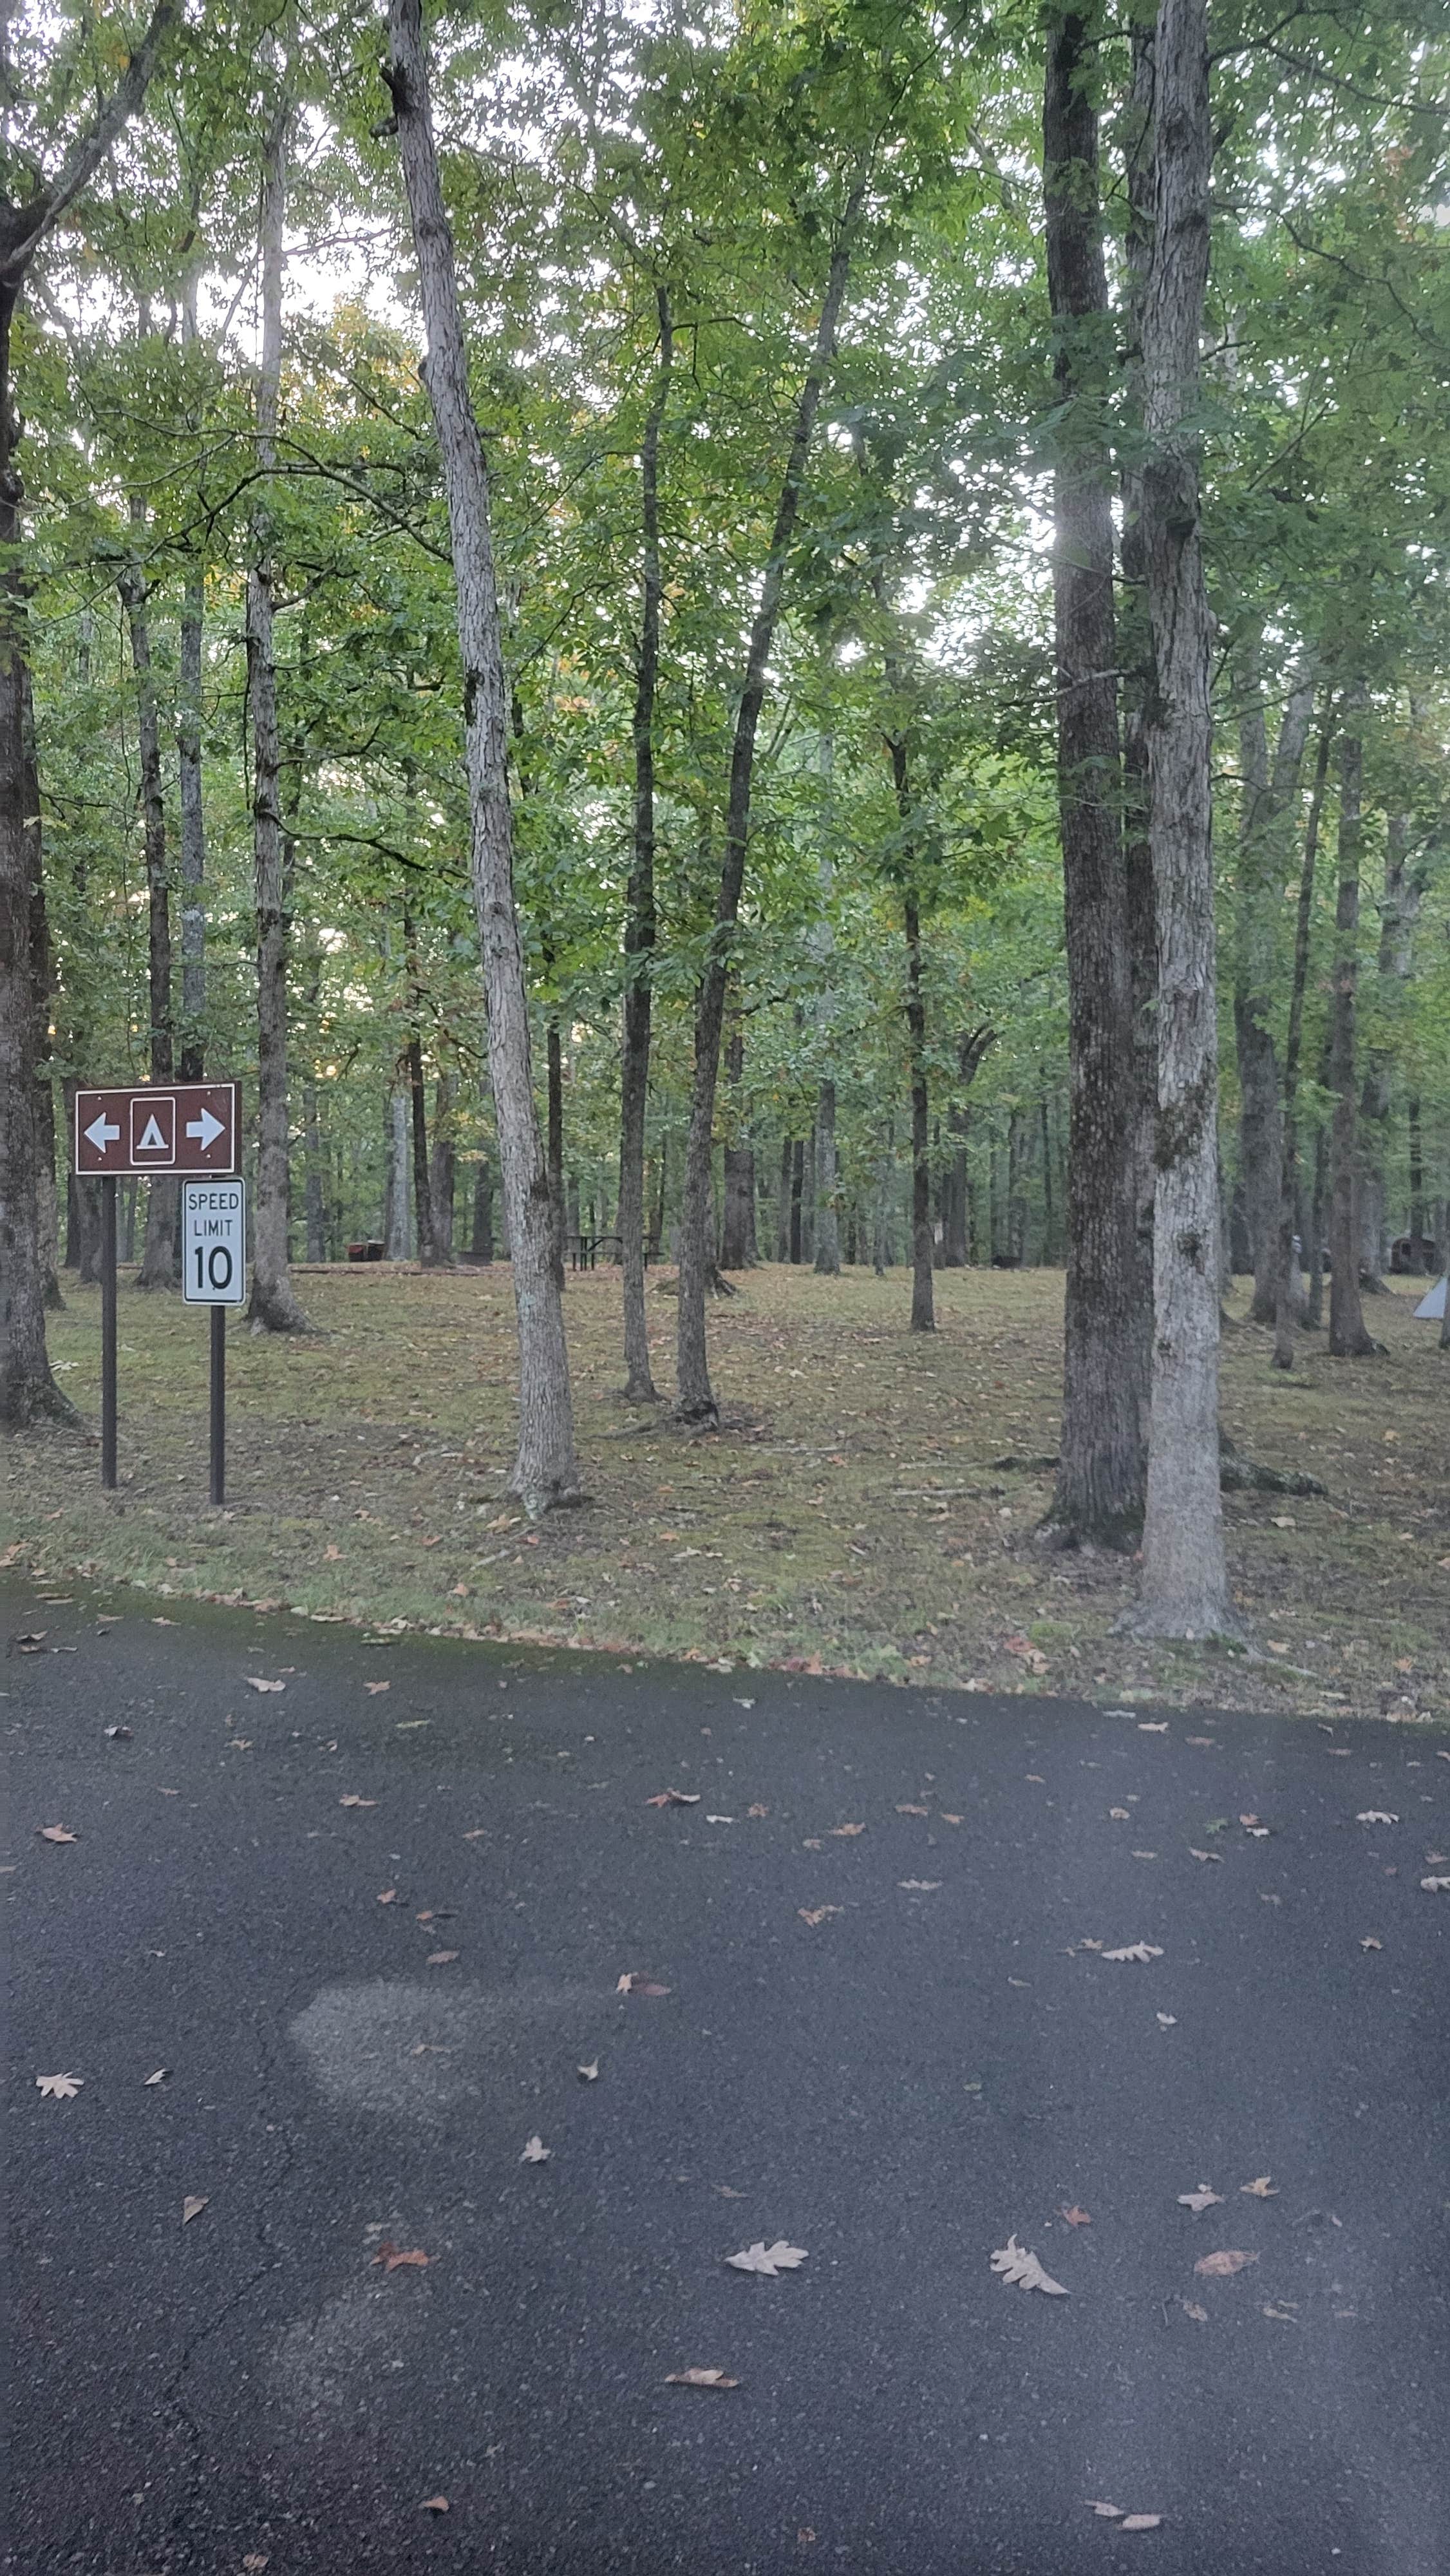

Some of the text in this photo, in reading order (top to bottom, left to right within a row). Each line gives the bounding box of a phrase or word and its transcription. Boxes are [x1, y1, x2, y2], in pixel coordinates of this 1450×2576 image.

[189, 1193, 239, 1209] SPEED
[194, 1220, 232, 1236] LIMIT
[194, 1246, 232, 1289] 10
